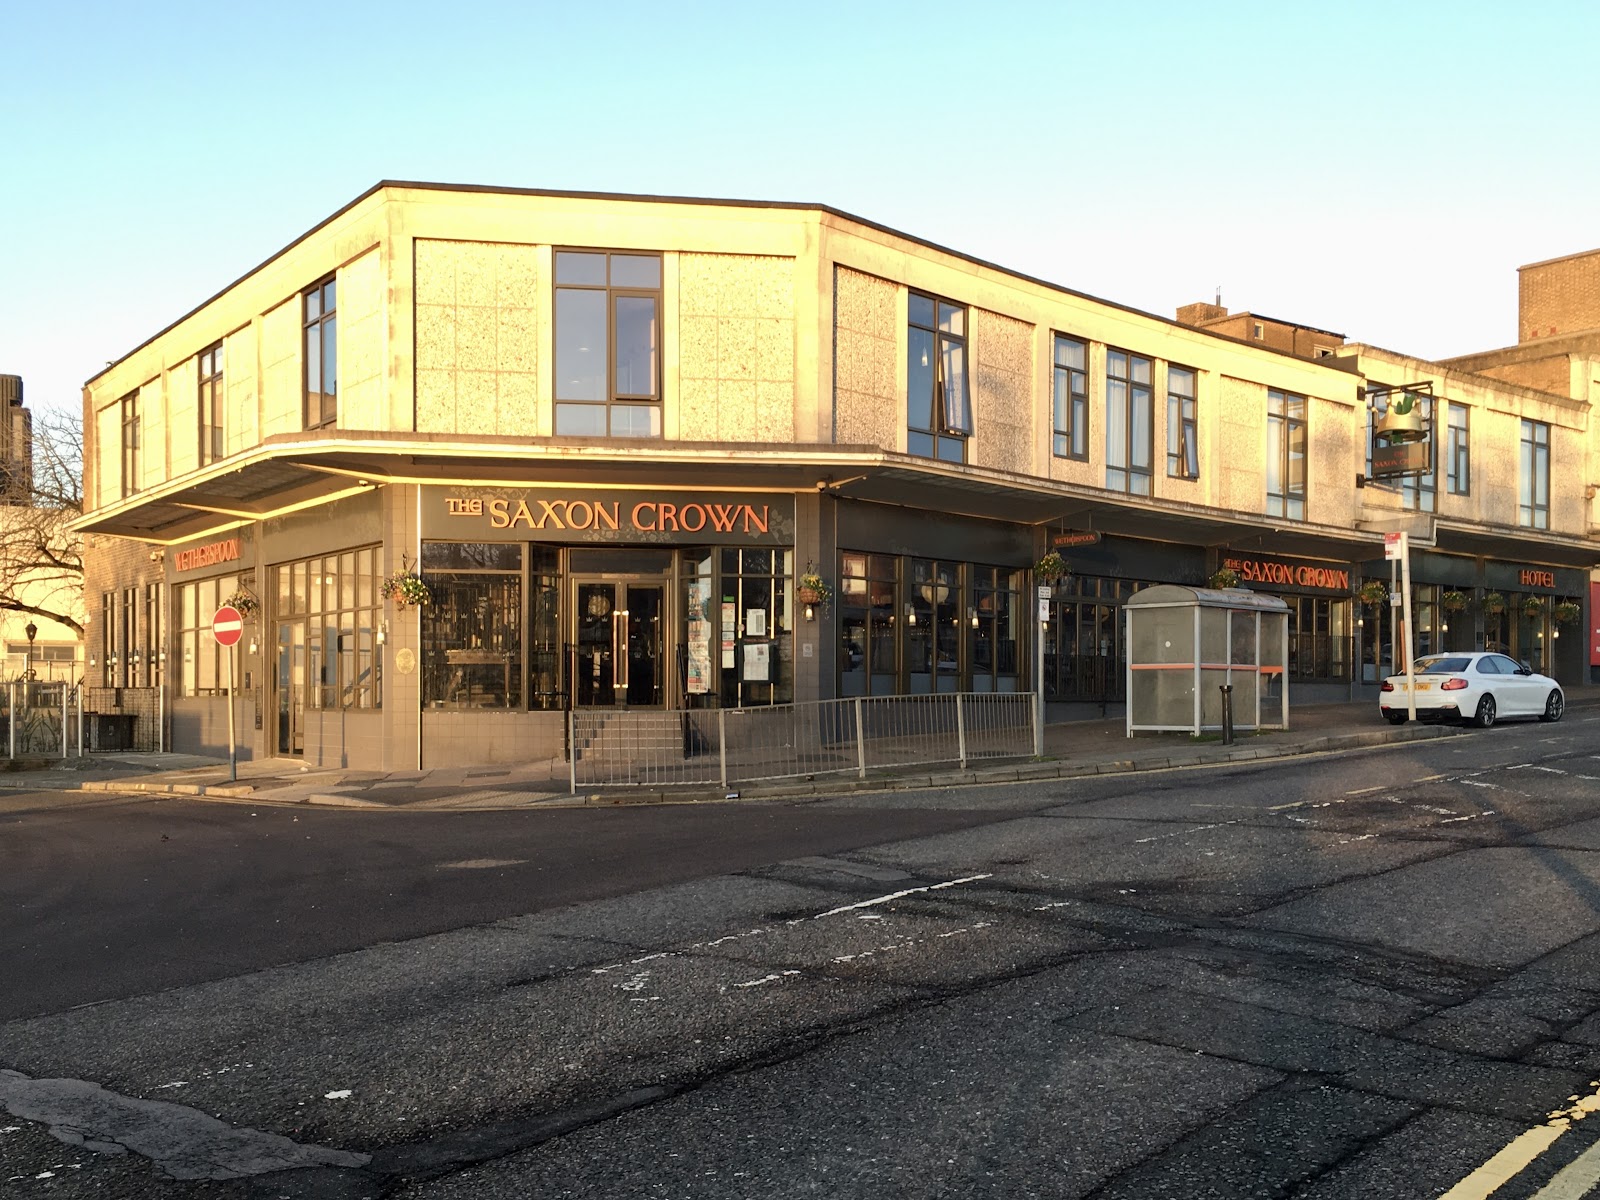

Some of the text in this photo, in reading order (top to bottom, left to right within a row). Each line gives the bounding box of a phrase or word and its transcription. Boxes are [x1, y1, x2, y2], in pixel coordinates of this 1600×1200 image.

[445, 498, 769, 534] THE SAXON CROWN
[174, 538, 240, 572] WETHERSPOON
[1224, 558, 1349, 590] THE SAXON CROWN
[1521, 569, 1556, 588] HOTEL
